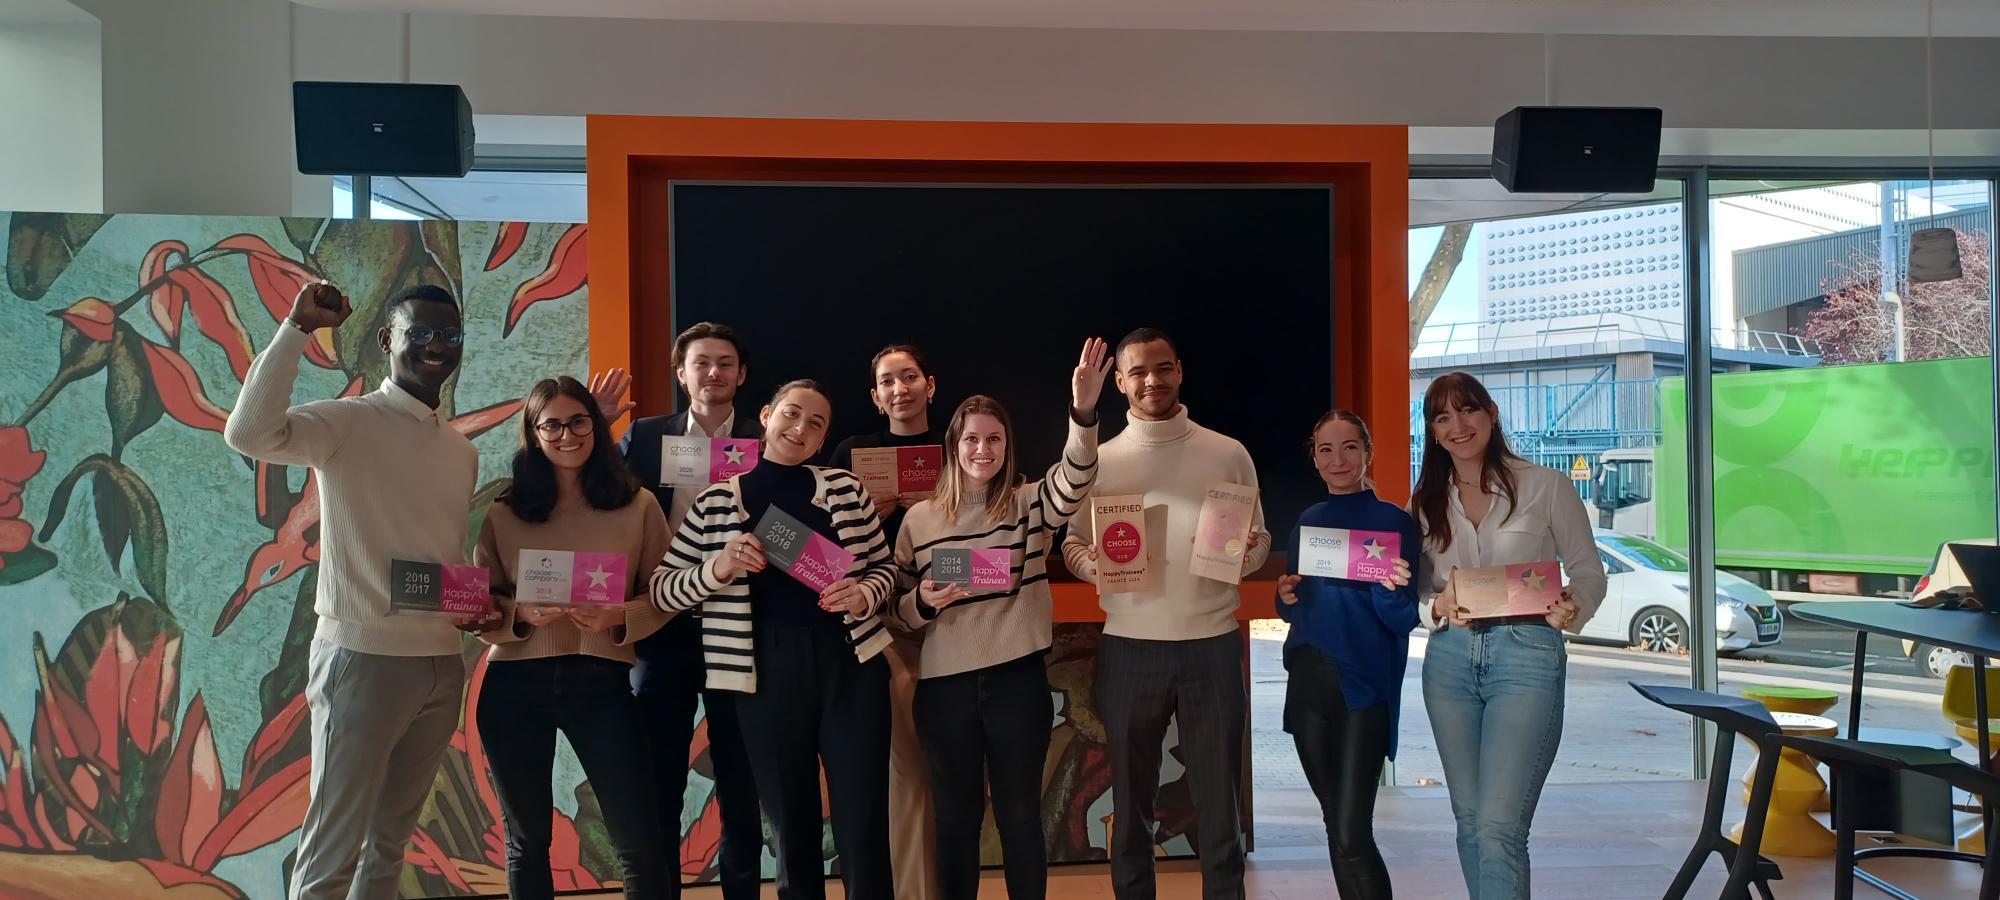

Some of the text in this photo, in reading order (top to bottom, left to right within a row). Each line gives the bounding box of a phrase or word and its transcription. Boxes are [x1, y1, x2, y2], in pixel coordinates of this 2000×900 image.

[671, 443, 701, 453] choose
[903, 468, 937, 477] choose
[1208, 489, 1253, 504] CERTIFIED
[1096, 504, 1142, 514] CERTIFIED
[771, 521, 797, 541] 2015
[766, 531, 791, 550] 2016
[1106, 539, 1137, 547] CHOOSE
[1309, 536, 1342, 546] choose
[800, 552, 832, 577] Happy
[941, 557, 961, 565] 2014
[941, 565, 962, 574] 2015
[972, 566, 999, 576] Happy
[1357, 564, 1387, 576] Happy
[405, 572, 430, 583] 2016
[794, 563, 829, 589] Trainee
[972, 575, 1006, 585] Trainees
[405, 583, 430, 594] 2017
[444, 588, 477, 600] Happy
[443, 600, 483, 612] Trainees
